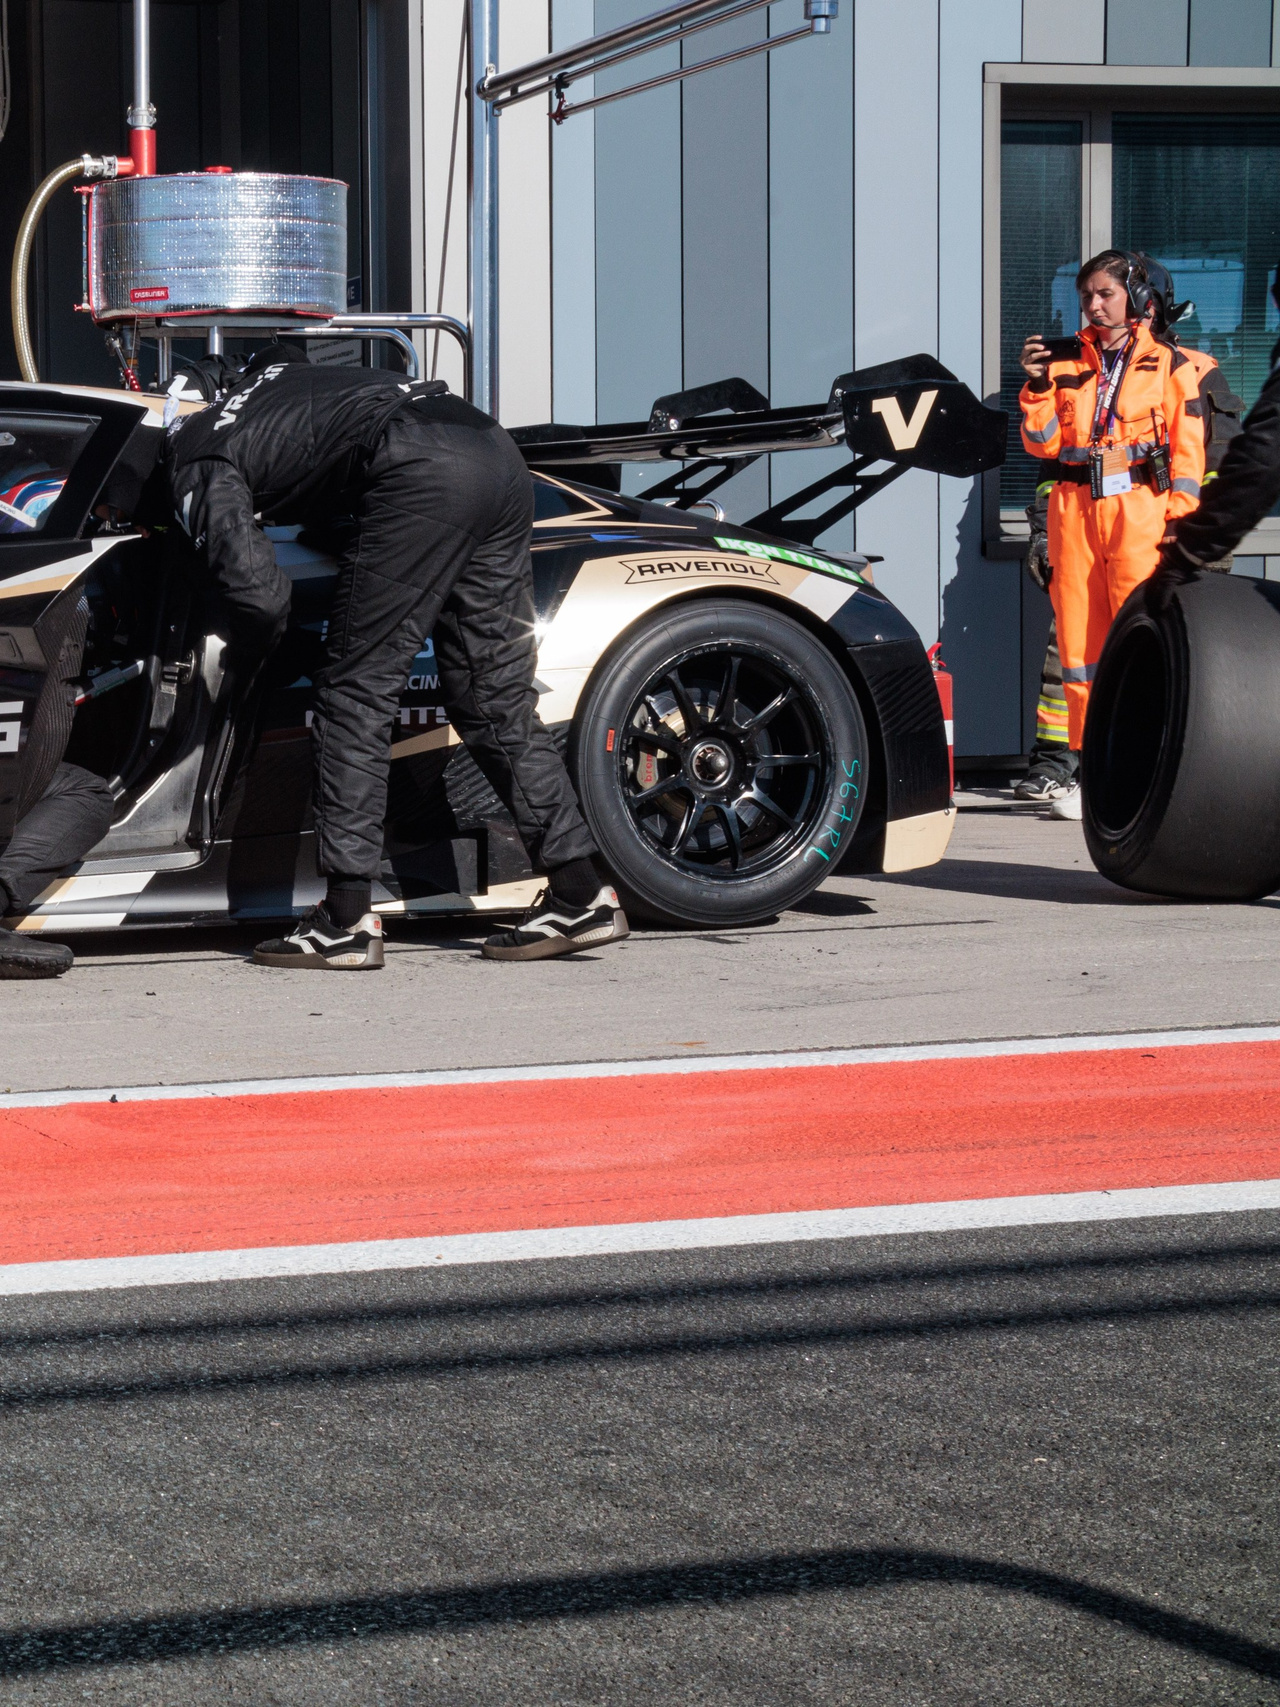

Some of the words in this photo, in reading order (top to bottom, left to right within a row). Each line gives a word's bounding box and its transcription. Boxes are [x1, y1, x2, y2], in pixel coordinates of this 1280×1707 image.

[871, 389, 939, 451] V
[636, 560, 766, 577] RAVENOL
[784, 549, 859, 582] TYRES
